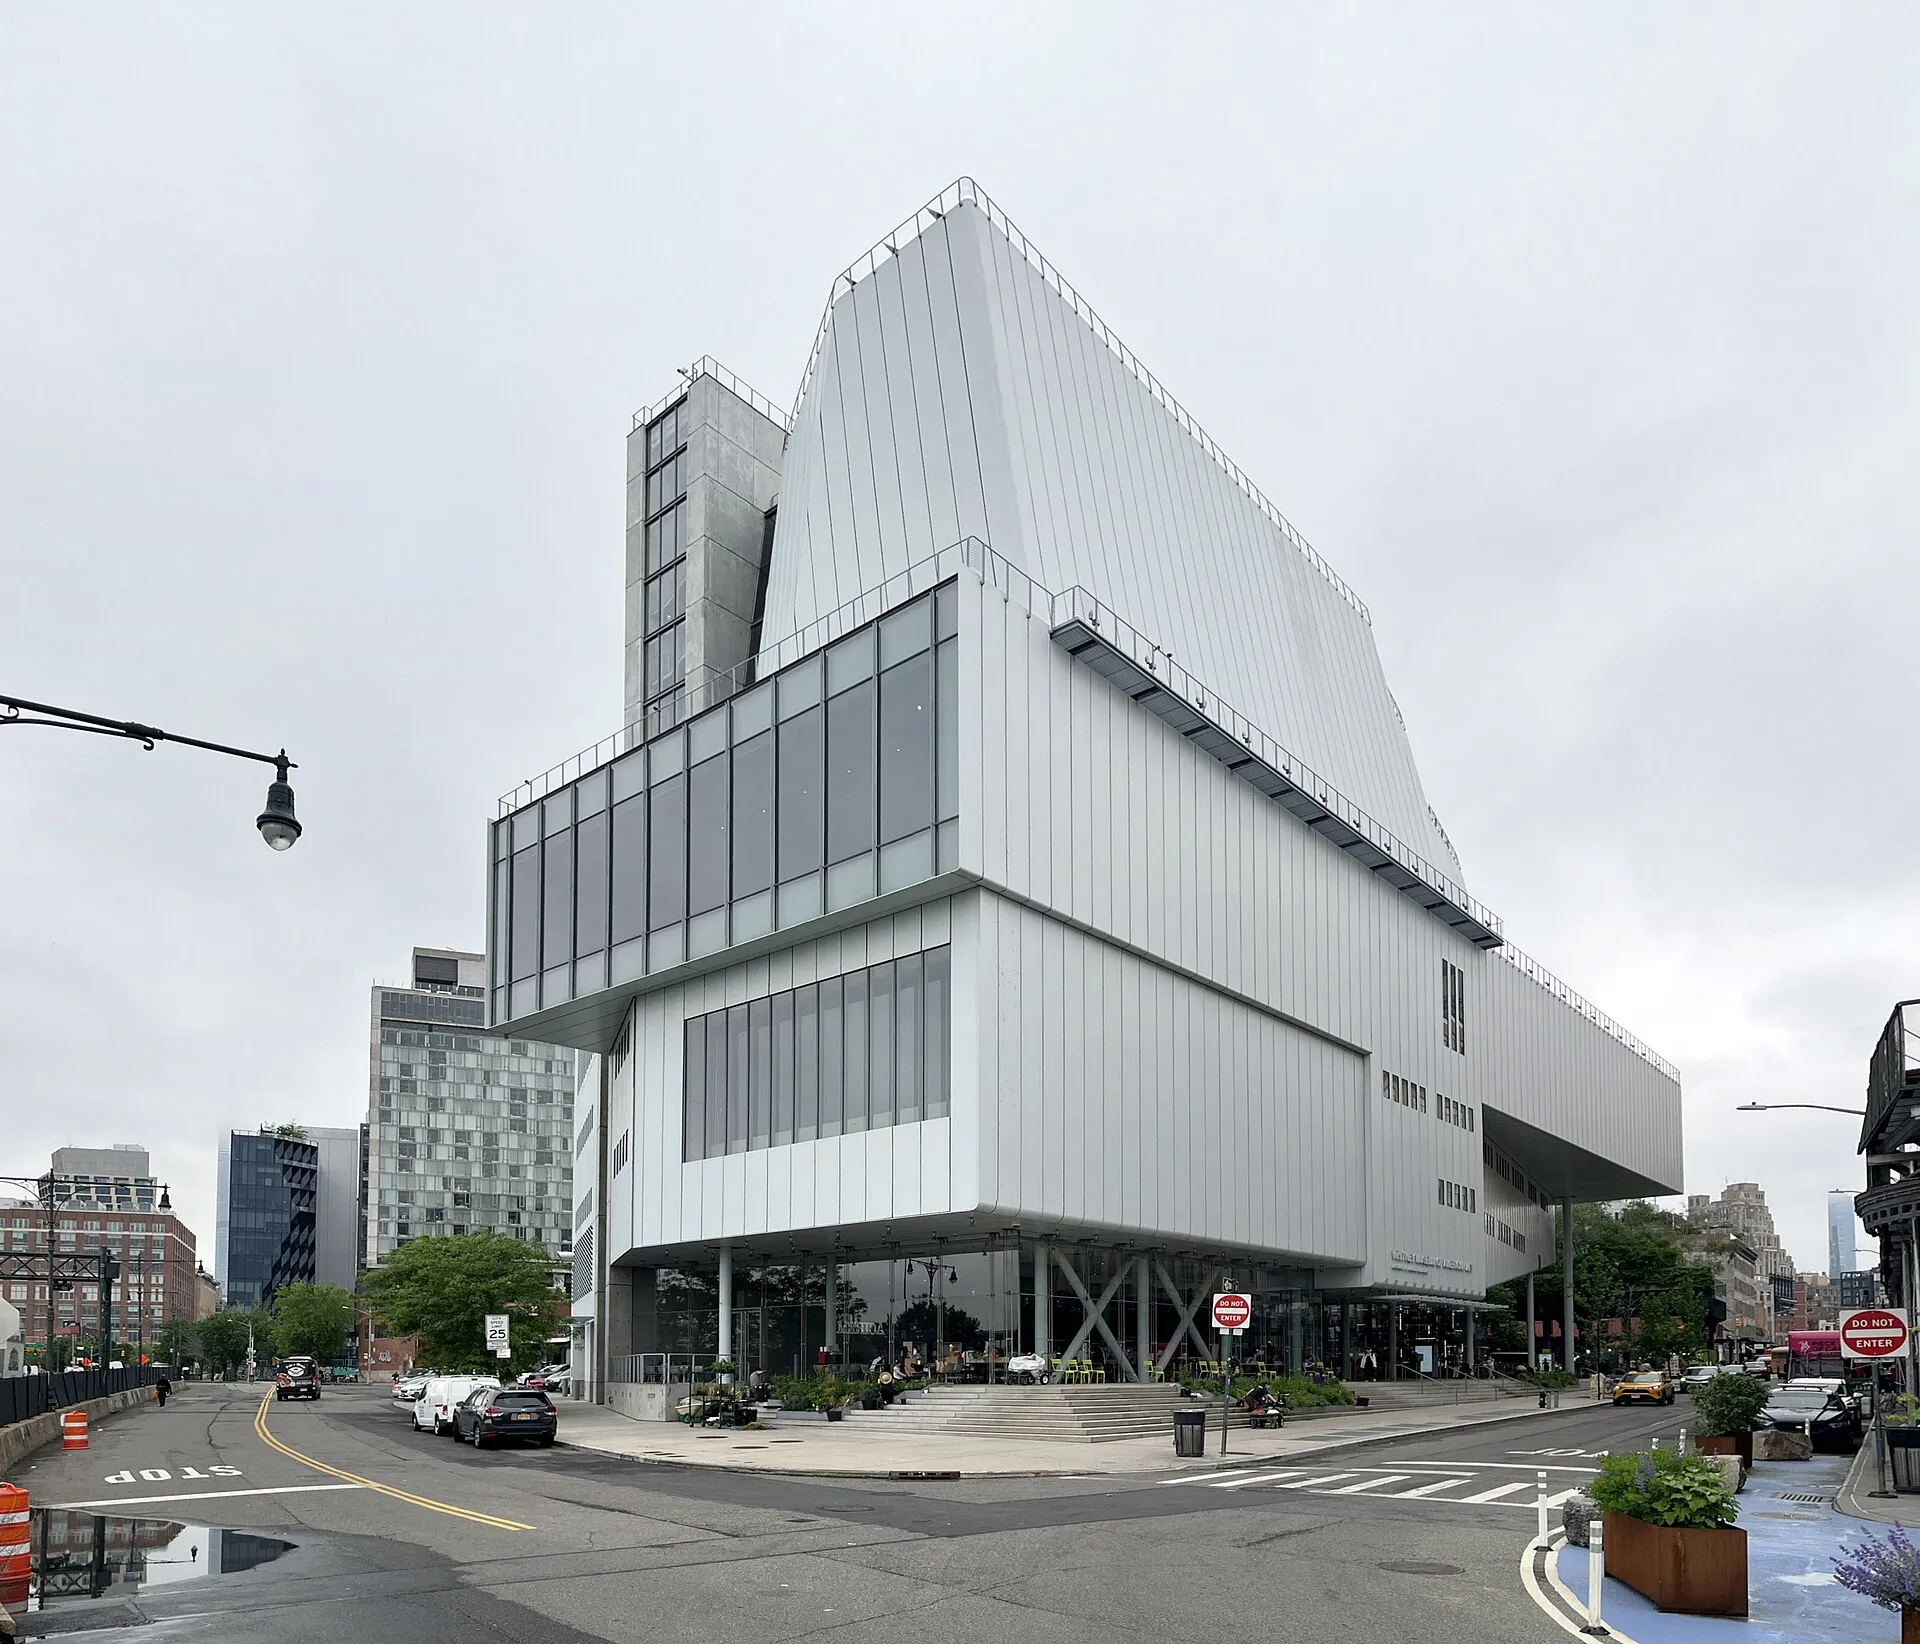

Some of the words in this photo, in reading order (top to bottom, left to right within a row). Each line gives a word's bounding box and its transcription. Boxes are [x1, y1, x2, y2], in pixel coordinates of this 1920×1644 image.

[1852, 1319, 1868, 1327] DO
[1873, 1319, 1894, 1327] NOT
[489, 1329, 506, 1339] 25
[1856, 1339, 1893, 1348] ENTER
[104, 1465, 243, 1484] STOP
